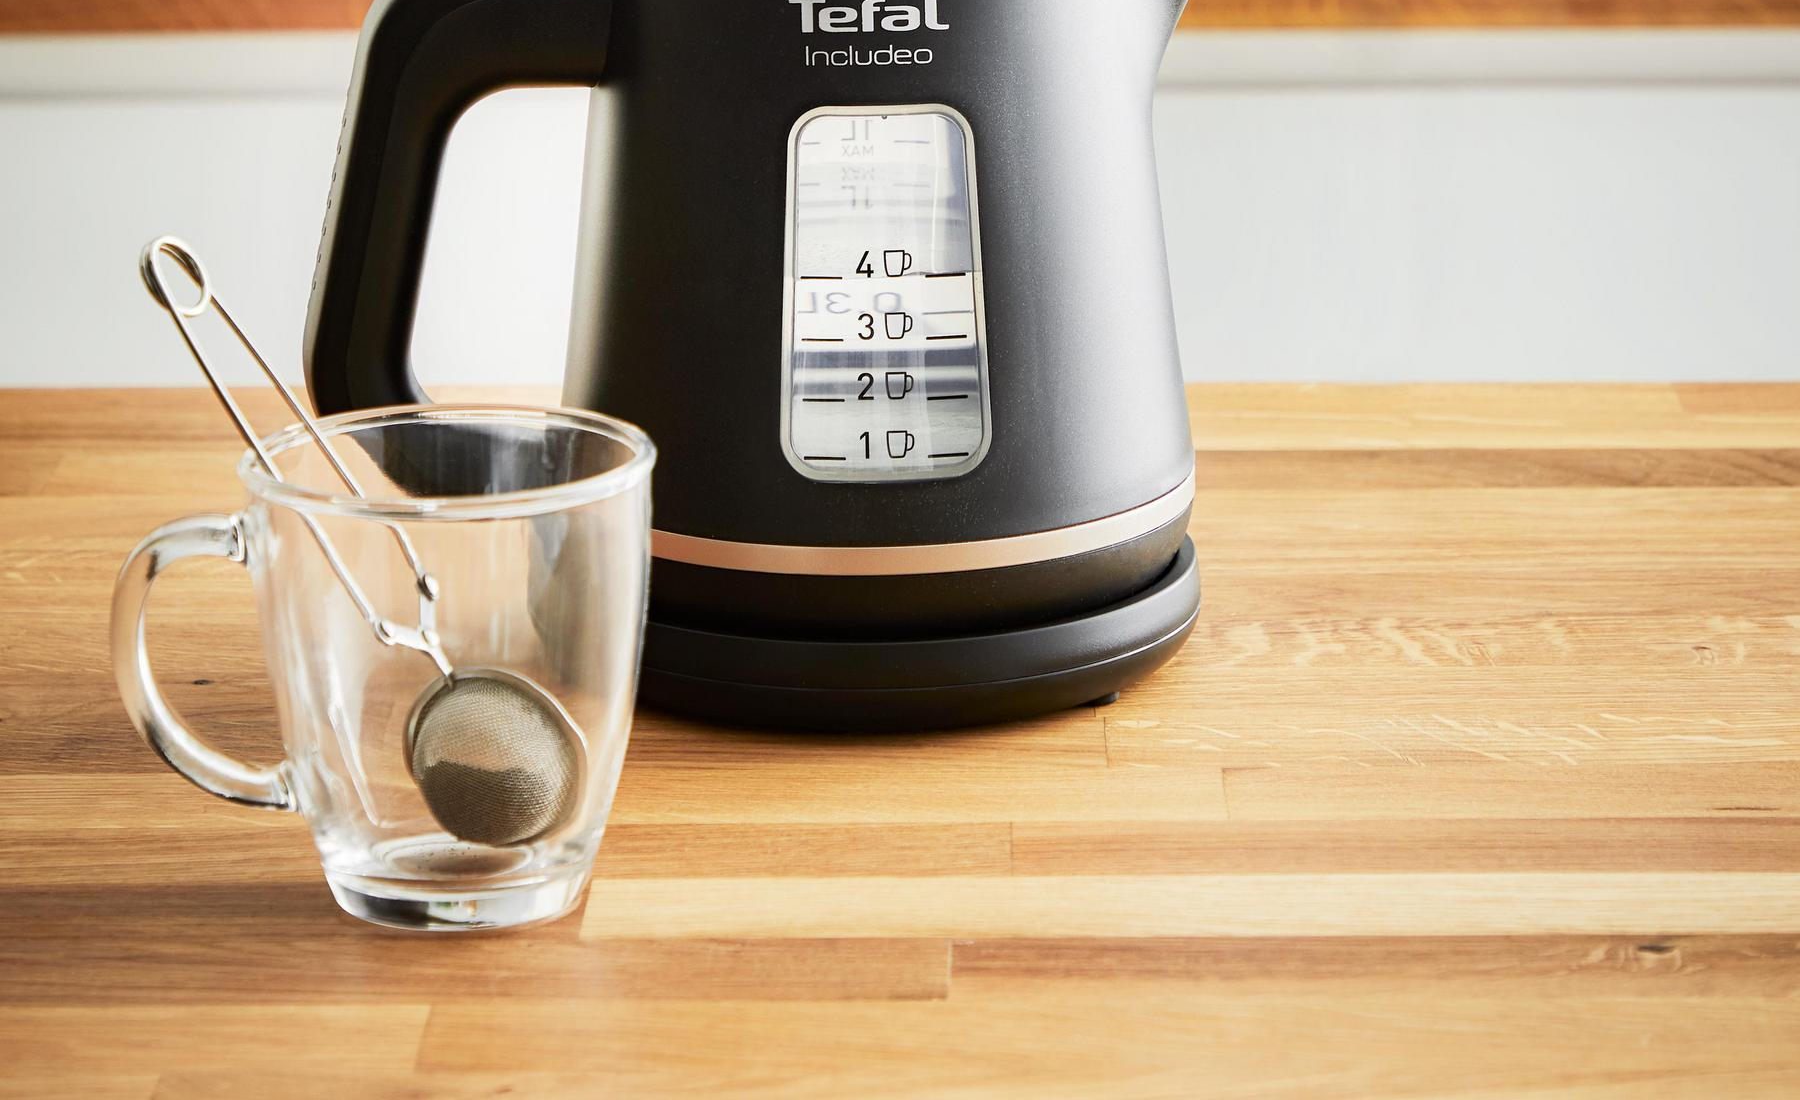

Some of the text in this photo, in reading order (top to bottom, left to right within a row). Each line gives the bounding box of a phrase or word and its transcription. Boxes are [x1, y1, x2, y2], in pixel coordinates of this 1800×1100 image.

[805, 44, 933, 66] Includeo
[855, 250, 874, 278] 4
[857, 313, 875, 340] 3
[857, 372, 875, 400] 2
[859, 431, 870, 459] 1
